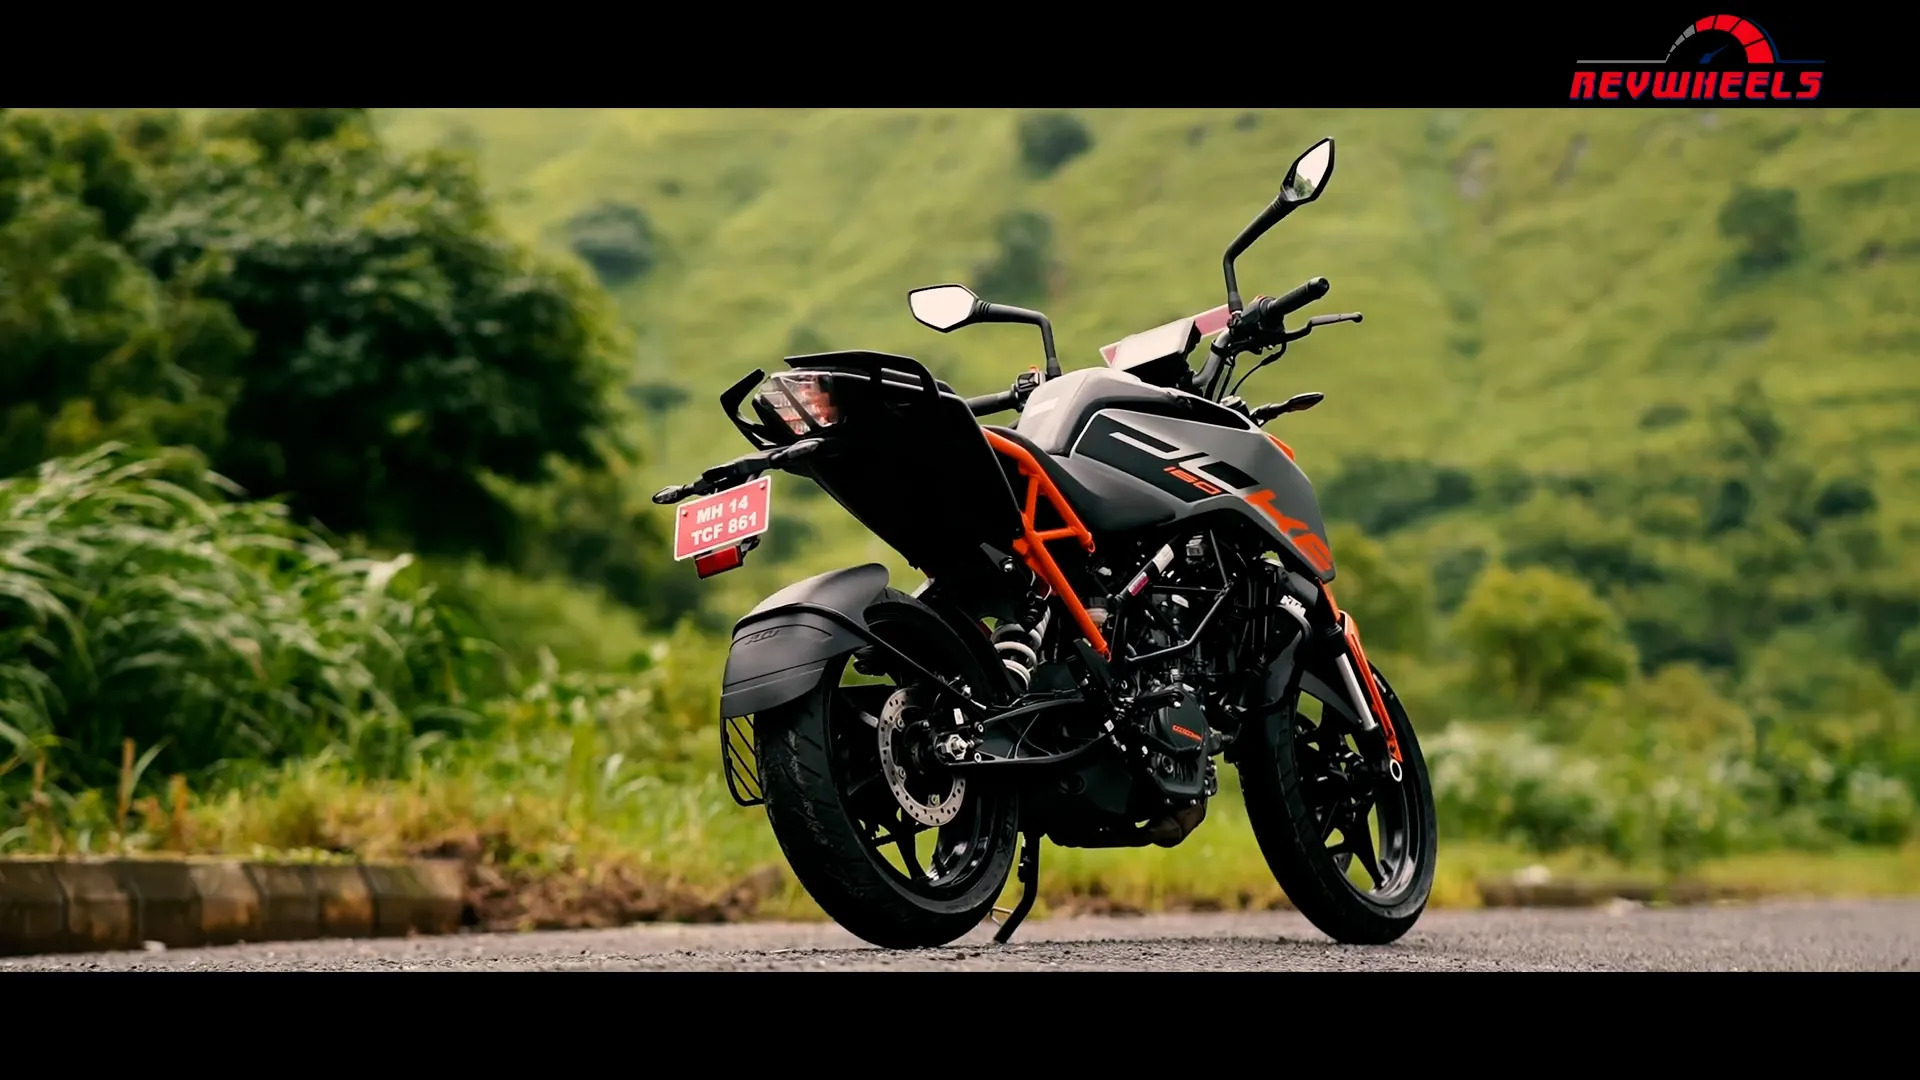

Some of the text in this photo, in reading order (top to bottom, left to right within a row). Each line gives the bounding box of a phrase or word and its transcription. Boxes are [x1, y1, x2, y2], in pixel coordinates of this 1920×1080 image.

[696, 495, 749, 524] MH 14
[691, 512, 757, 546] TCF 861
